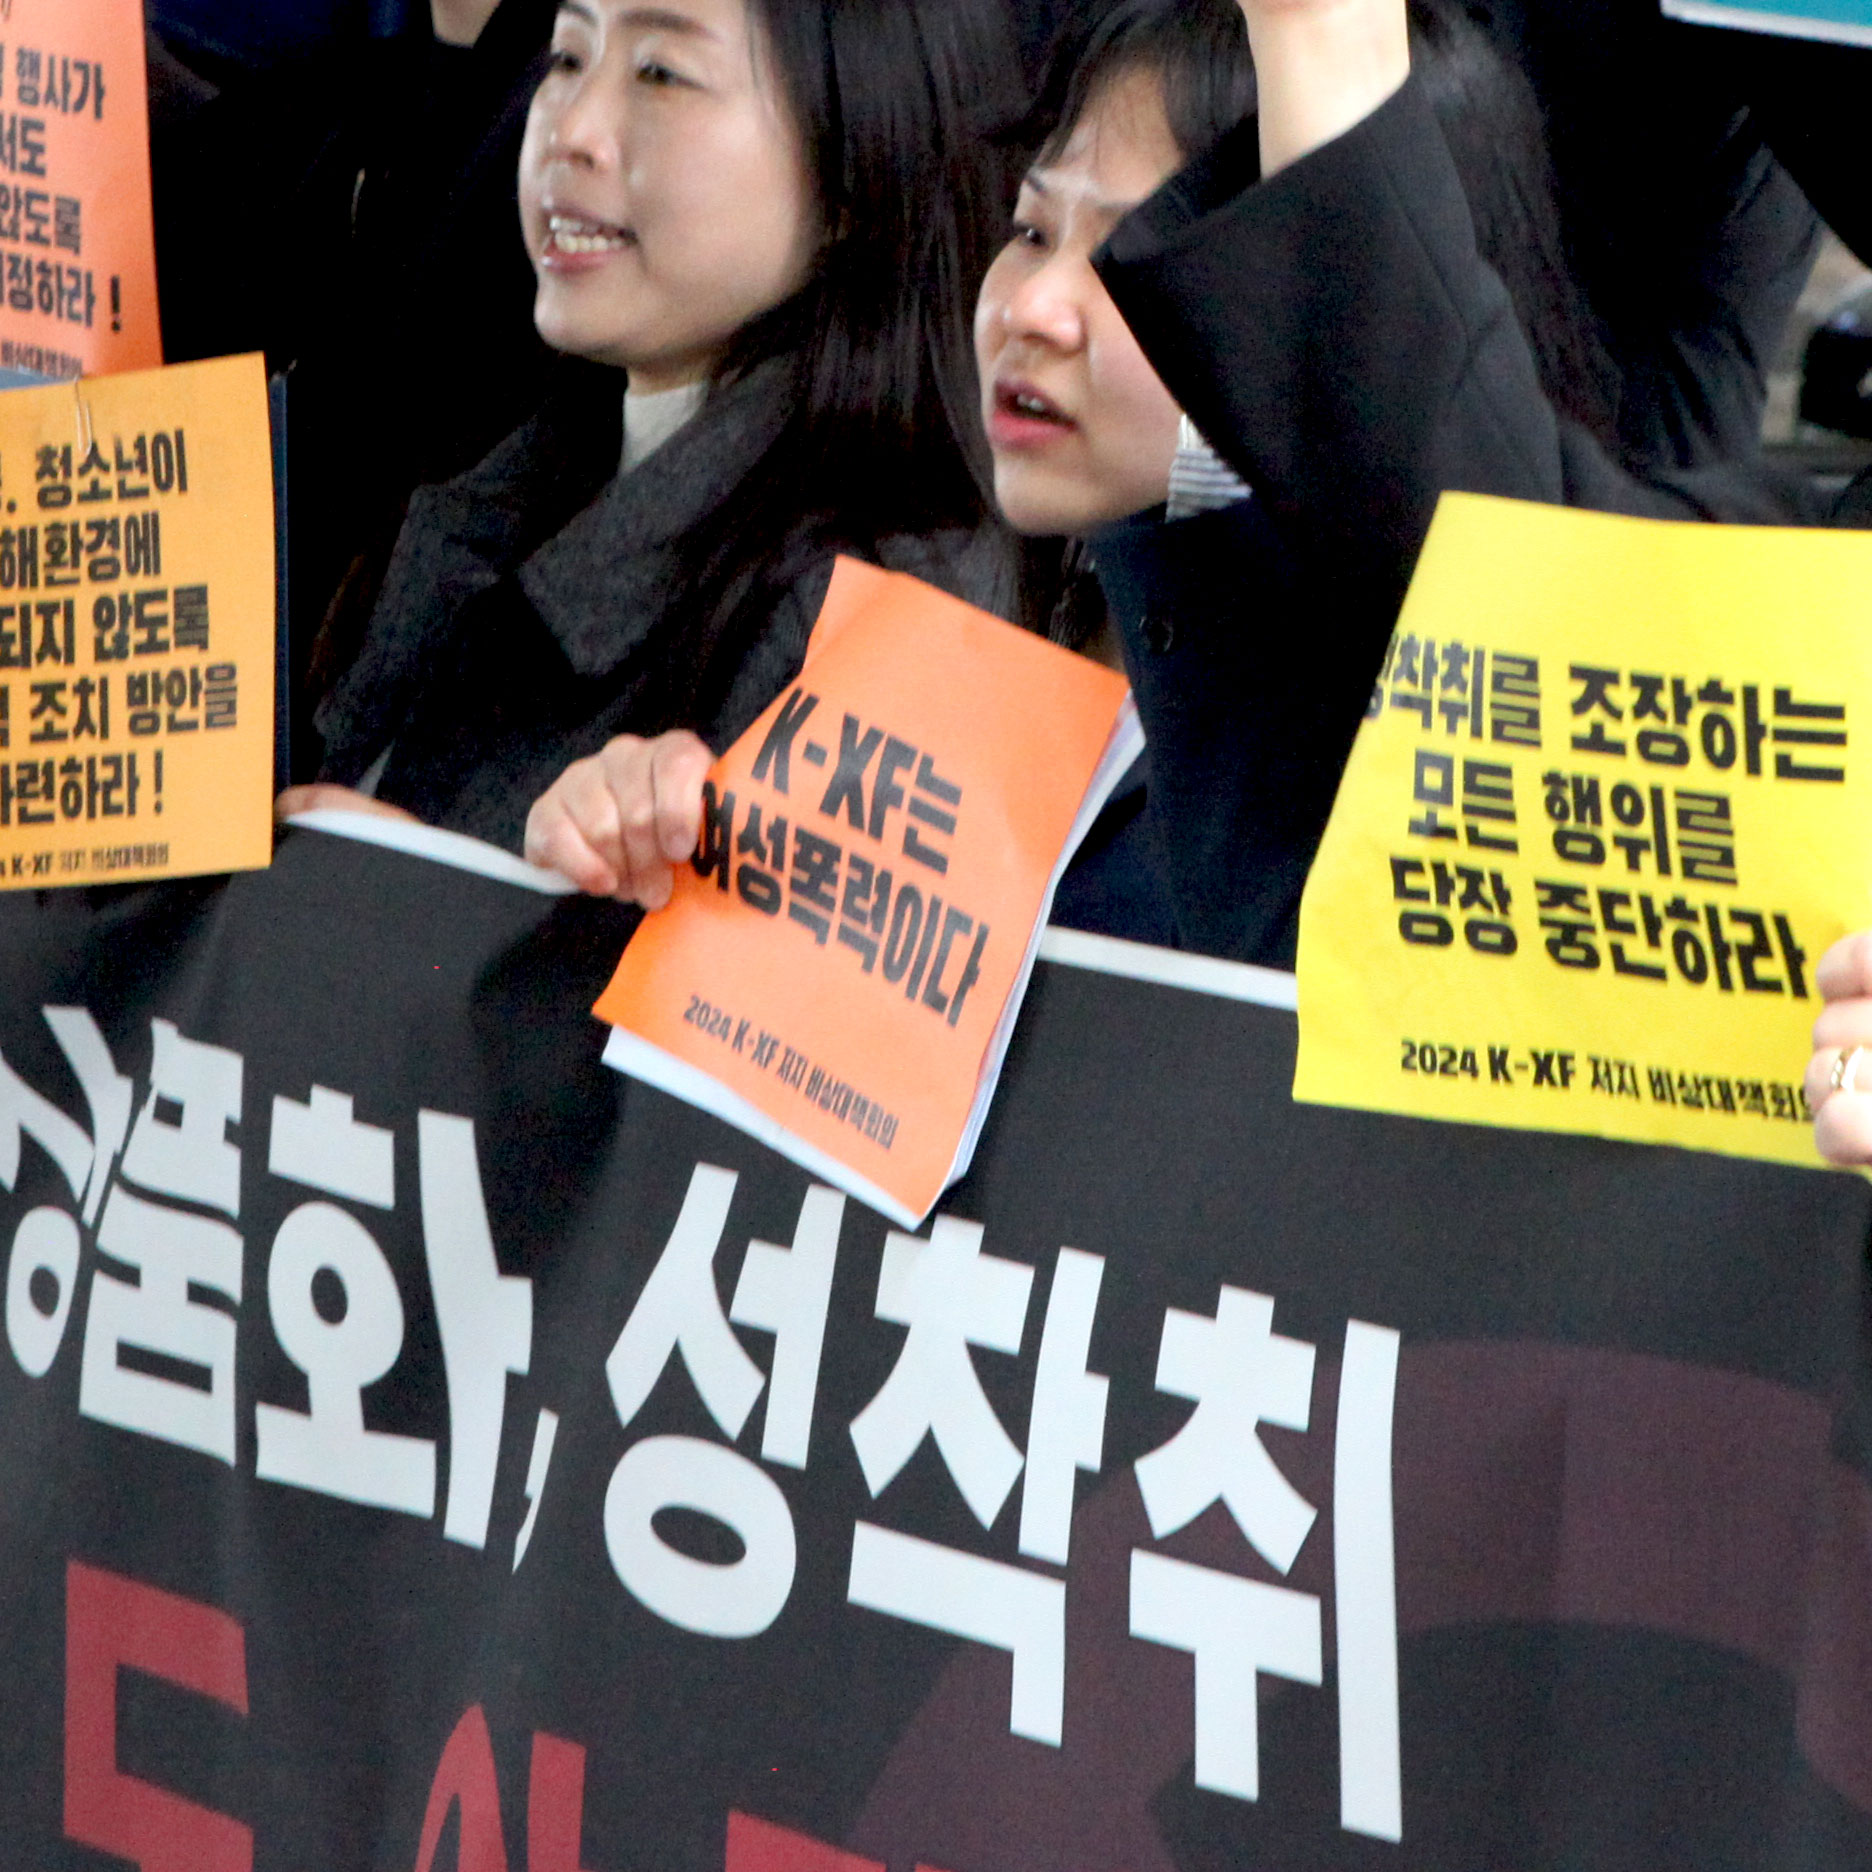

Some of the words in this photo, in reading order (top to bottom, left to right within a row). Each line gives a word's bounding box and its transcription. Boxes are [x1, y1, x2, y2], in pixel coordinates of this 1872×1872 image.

[16, 46, 105, 120] 행사가
[35, 426, 188, 509] 청소년이
[92, 583, 209, 663] 않도록
[29, 675, 109, 745] 조치
[127, 661, 237, 737] 방안을
[1568, 663, 1847, 782] 조장하는
[750, 687, 962, 875] K-XF는
[1407, 748, 1519, 855] 모든
[1541, 770, 1737, 886] 행위를
[12, 851, 53, 877] K-XF
[691, 780, 989, 1028] 여성폭력이다
[1390, 856, 1519, 959] 당장
[1533, 877, 1810, 1000] 중단하라
[684, 994, 732, 1042] 2024
[732, 1018, 780, 1070] K-XF
[777, 1046, 809, 1092] 저지
[1400, 1039, 1480, 1081] 2024
[1486, 1045, 1576, 1089] K-XF
[1587, 1054, 1640, 1101] 저지
[605, 1161, 1403, 1842] 성착취
